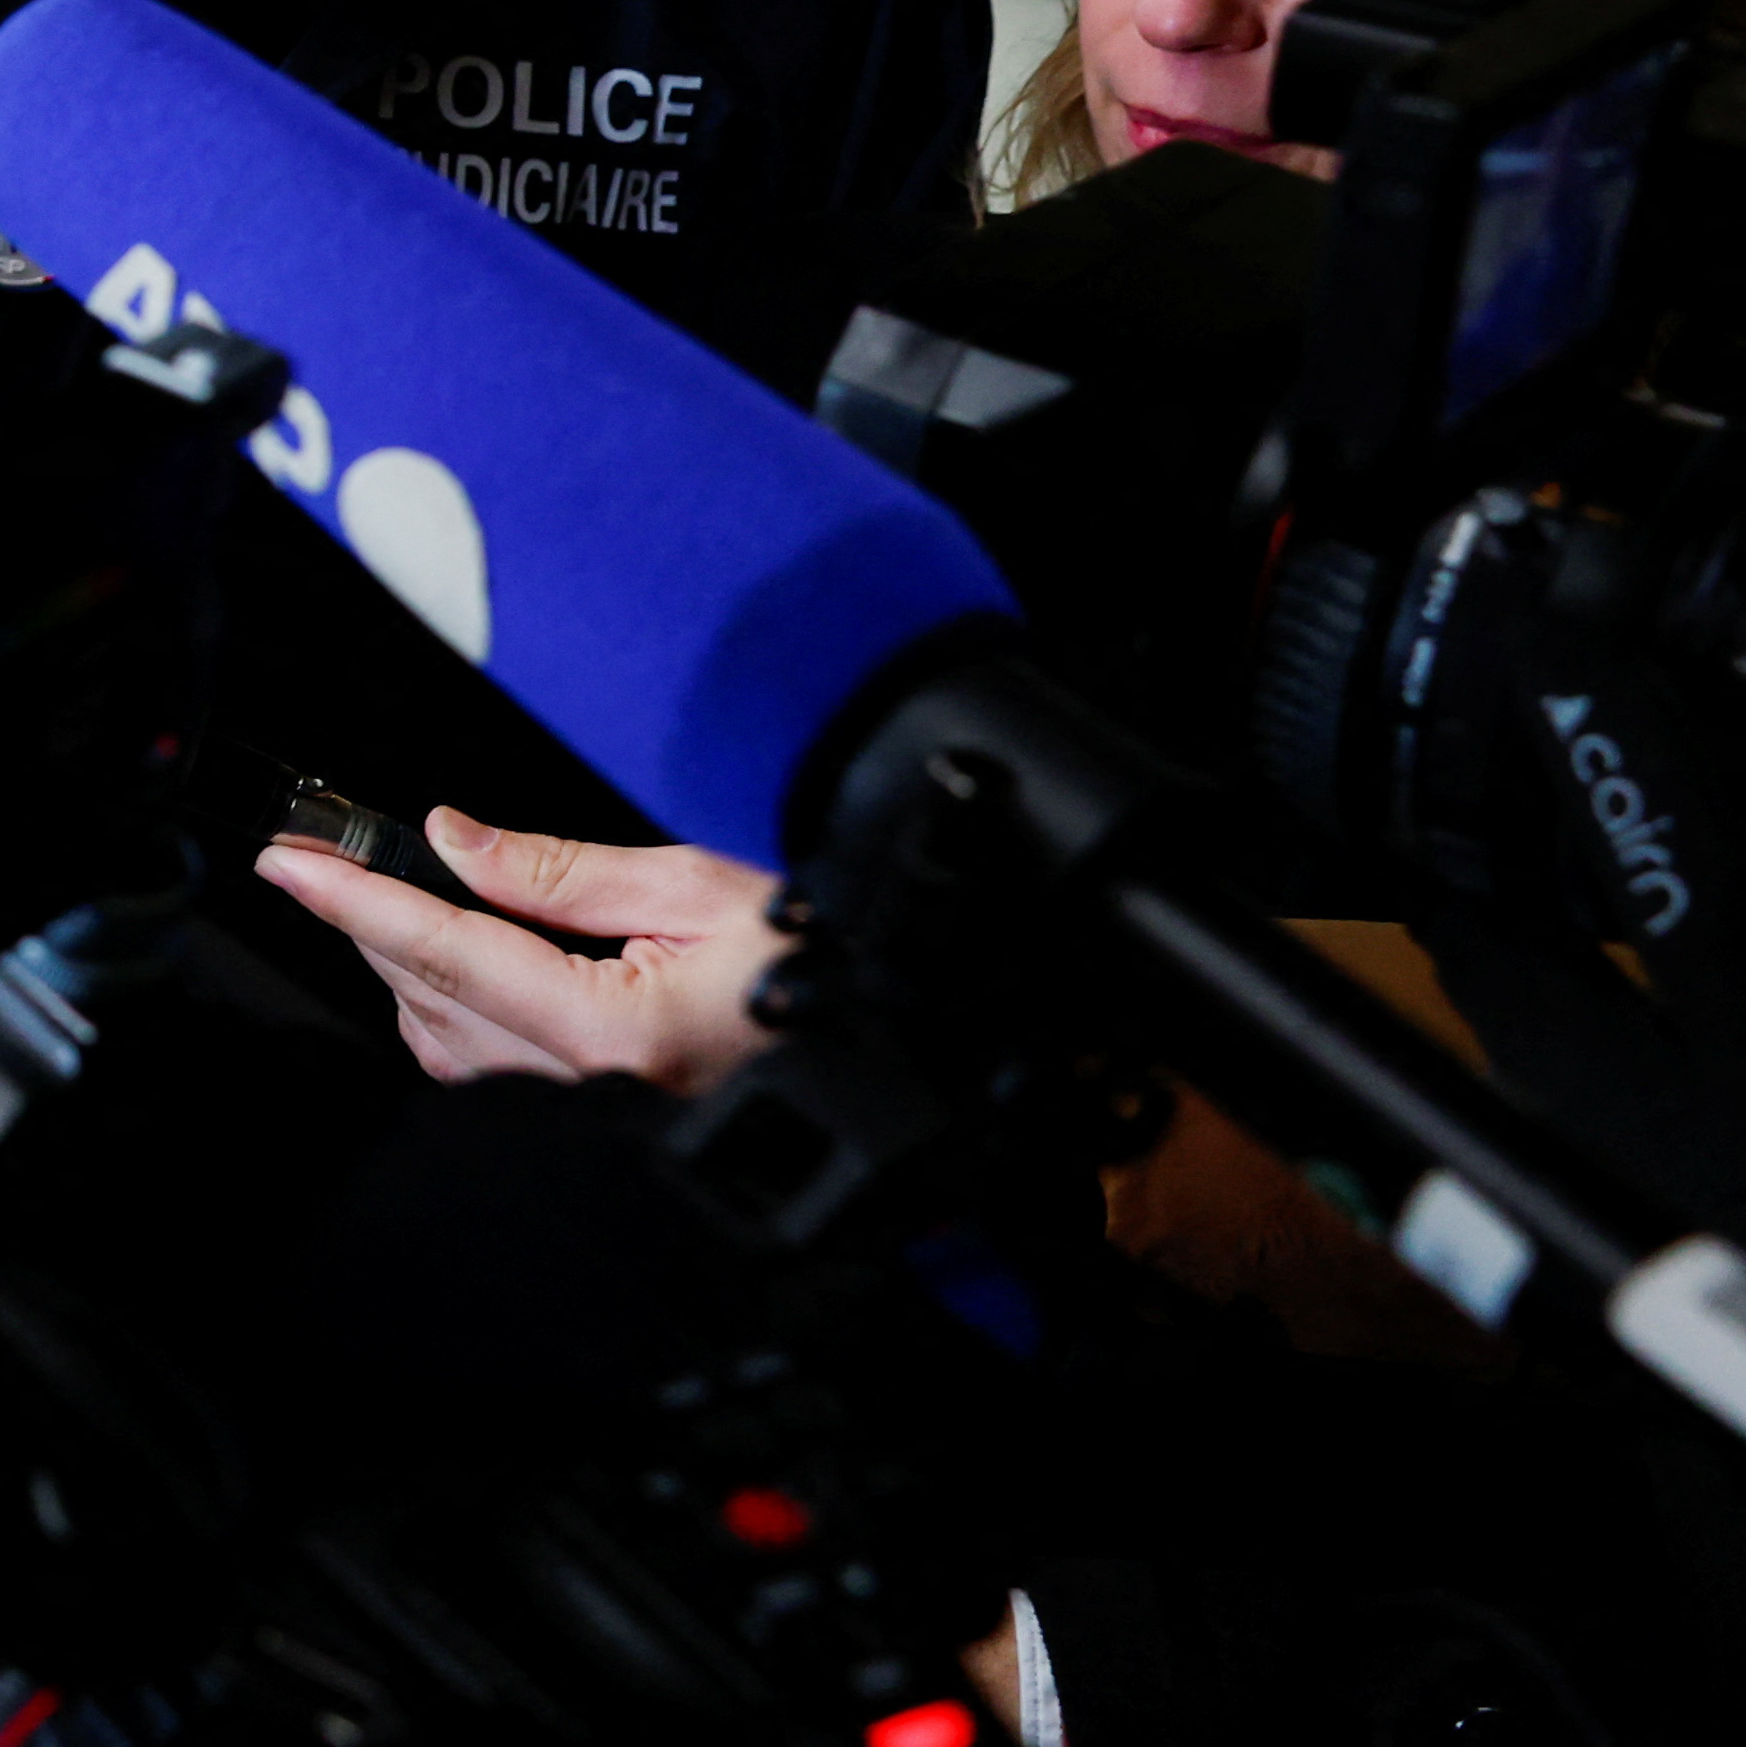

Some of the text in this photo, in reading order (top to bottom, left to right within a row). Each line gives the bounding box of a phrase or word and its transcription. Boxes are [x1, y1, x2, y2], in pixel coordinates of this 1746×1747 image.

[377, 51, 704, 147] POLICE
[399, 148, 681, 235] DICIAIRE
[1568, 730, 1693, 939] cairn
